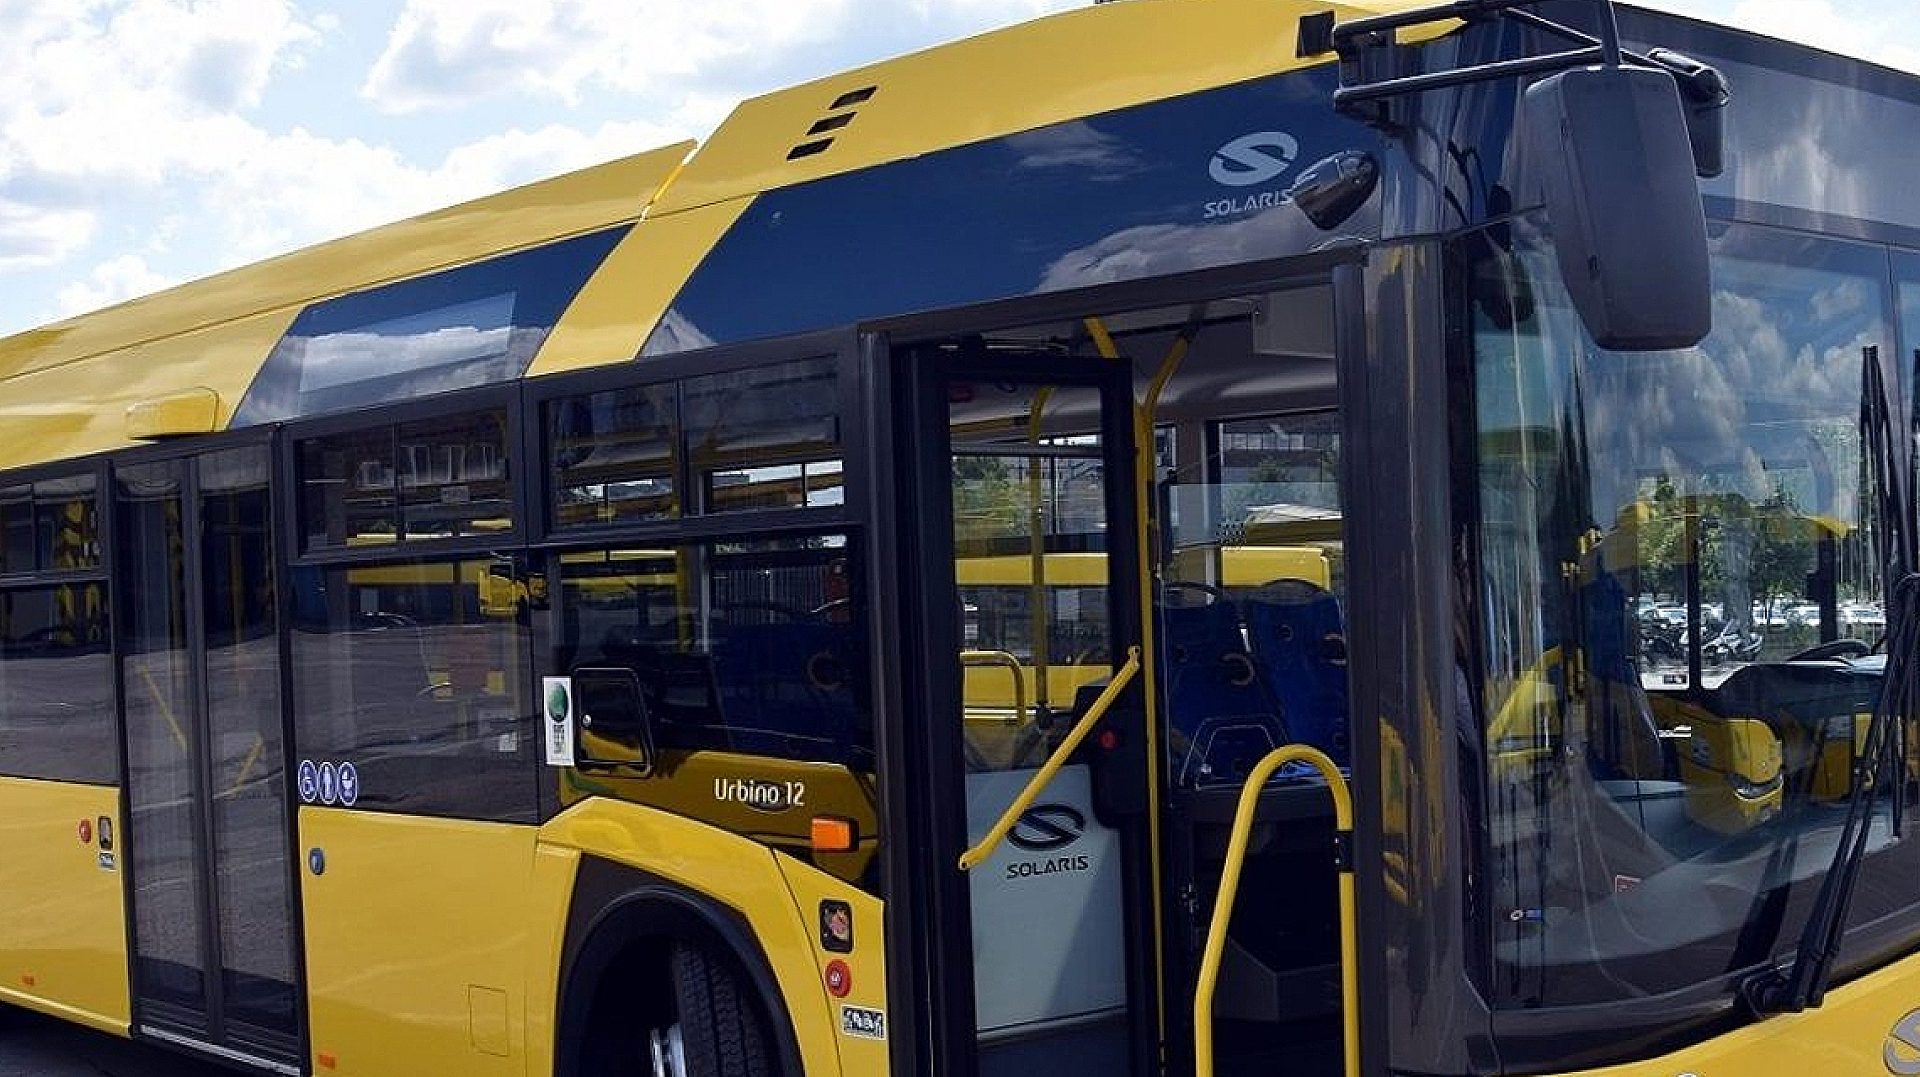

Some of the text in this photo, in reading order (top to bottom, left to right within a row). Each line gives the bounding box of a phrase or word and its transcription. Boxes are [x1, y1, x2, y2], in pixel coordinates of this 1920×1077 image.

[1203, 189, 1293, 219] SOLARIS
[714, 778, 806, 807] Urbino 12
[1006, 855, 1089, 879] SOLARIS
